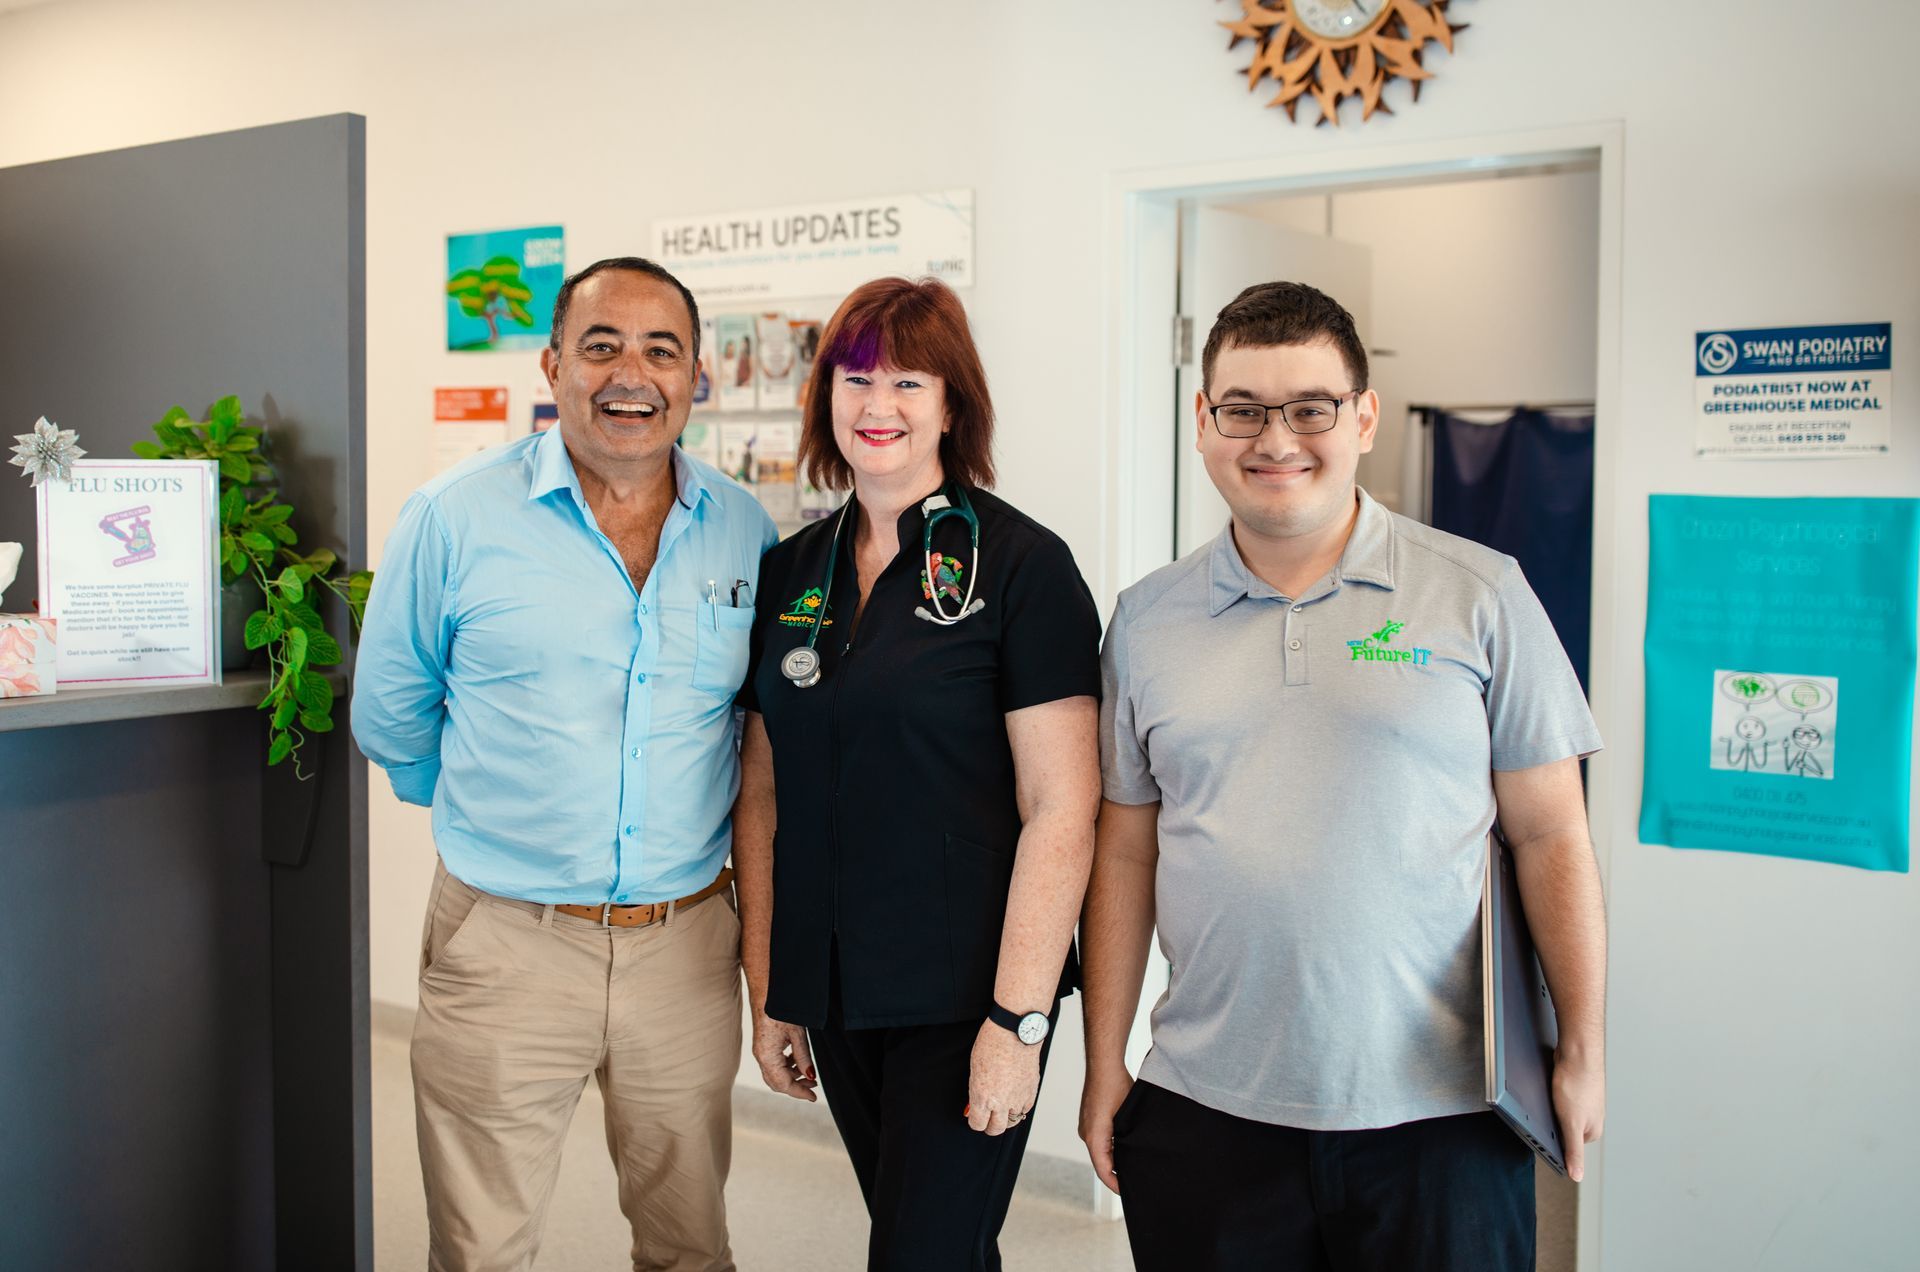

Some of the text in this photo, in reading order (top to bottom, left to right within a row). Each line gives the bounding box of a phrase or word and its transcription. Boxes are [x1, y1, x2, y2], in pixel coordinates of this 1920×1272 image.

[661, 206, 902, 257] HEALTH UPDATES
[1743, 335, 1888, 358] SWAN PODIATRY
[1769, 353, 1861, 366] AND ORTHOTICS
[1713, 379, 1872, 397] PODIATRIST NOW AT
[1703, 397, 1882, 415] GREENHOUSE MEDICAL
[1728, 420, 1852, 433] ENQUIRE AT RECEPTION
[1750, 434, 1775, 444] CALL
[69, 477, 183, 493] FLU SHOTS
